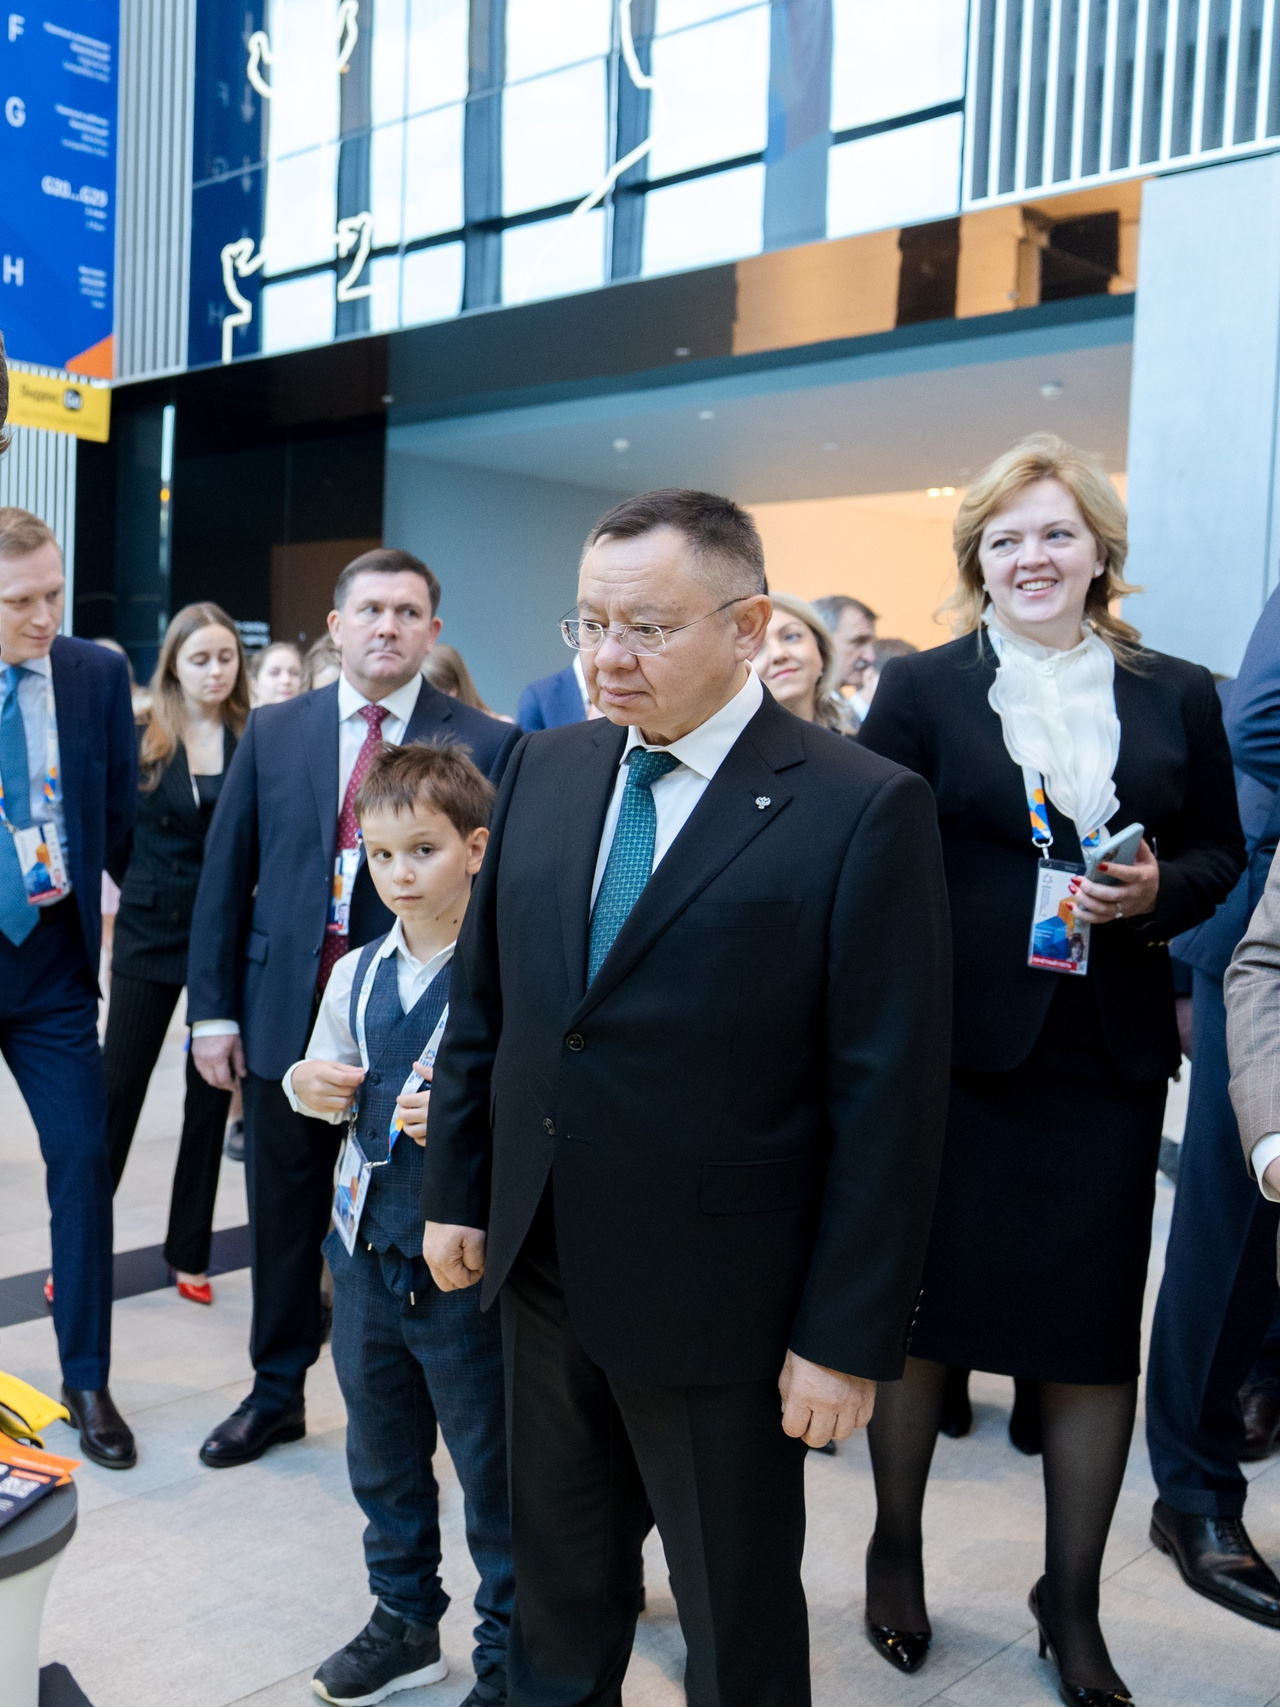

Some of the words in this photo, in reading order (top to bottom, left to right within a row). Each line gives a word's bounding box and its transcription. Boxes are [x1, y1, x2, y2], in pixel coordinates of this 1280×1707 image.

[8, 13, 25, 42] F
[5, 96, 26, 128] G
[3, 254, 24, 287] H
